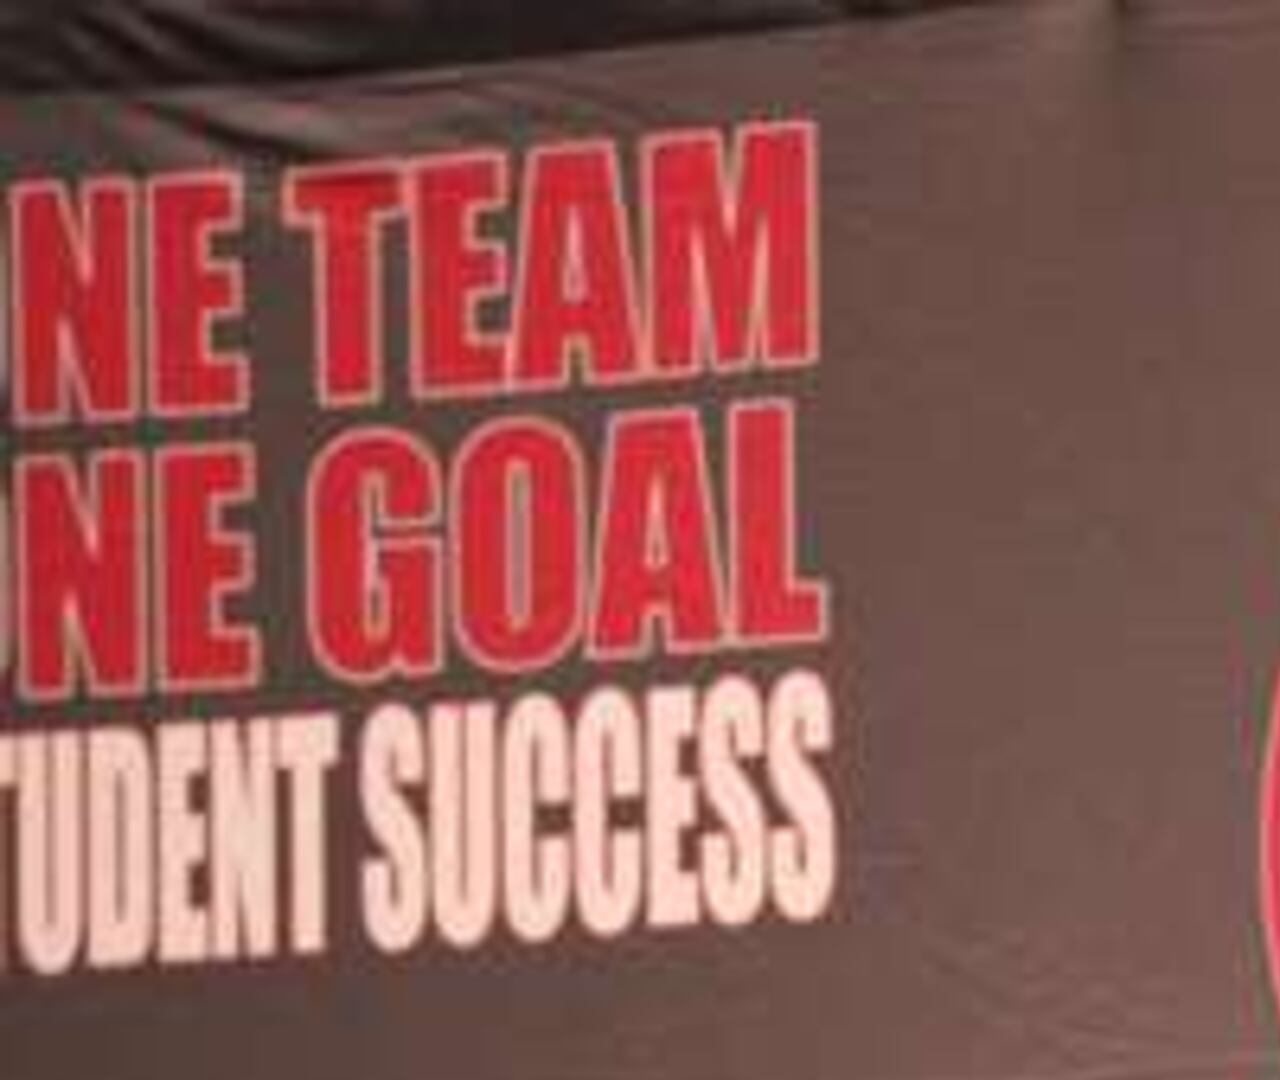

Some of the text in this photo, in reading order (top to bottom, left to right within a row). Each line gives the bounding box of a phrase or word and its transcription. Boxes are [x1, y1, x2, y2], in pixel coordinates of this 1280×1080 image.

[0, 121, 821, 425] NE TEAM
[0, 401, 829, 702] NE GOAL
[359, 671, 837, 953] SUCCESS
